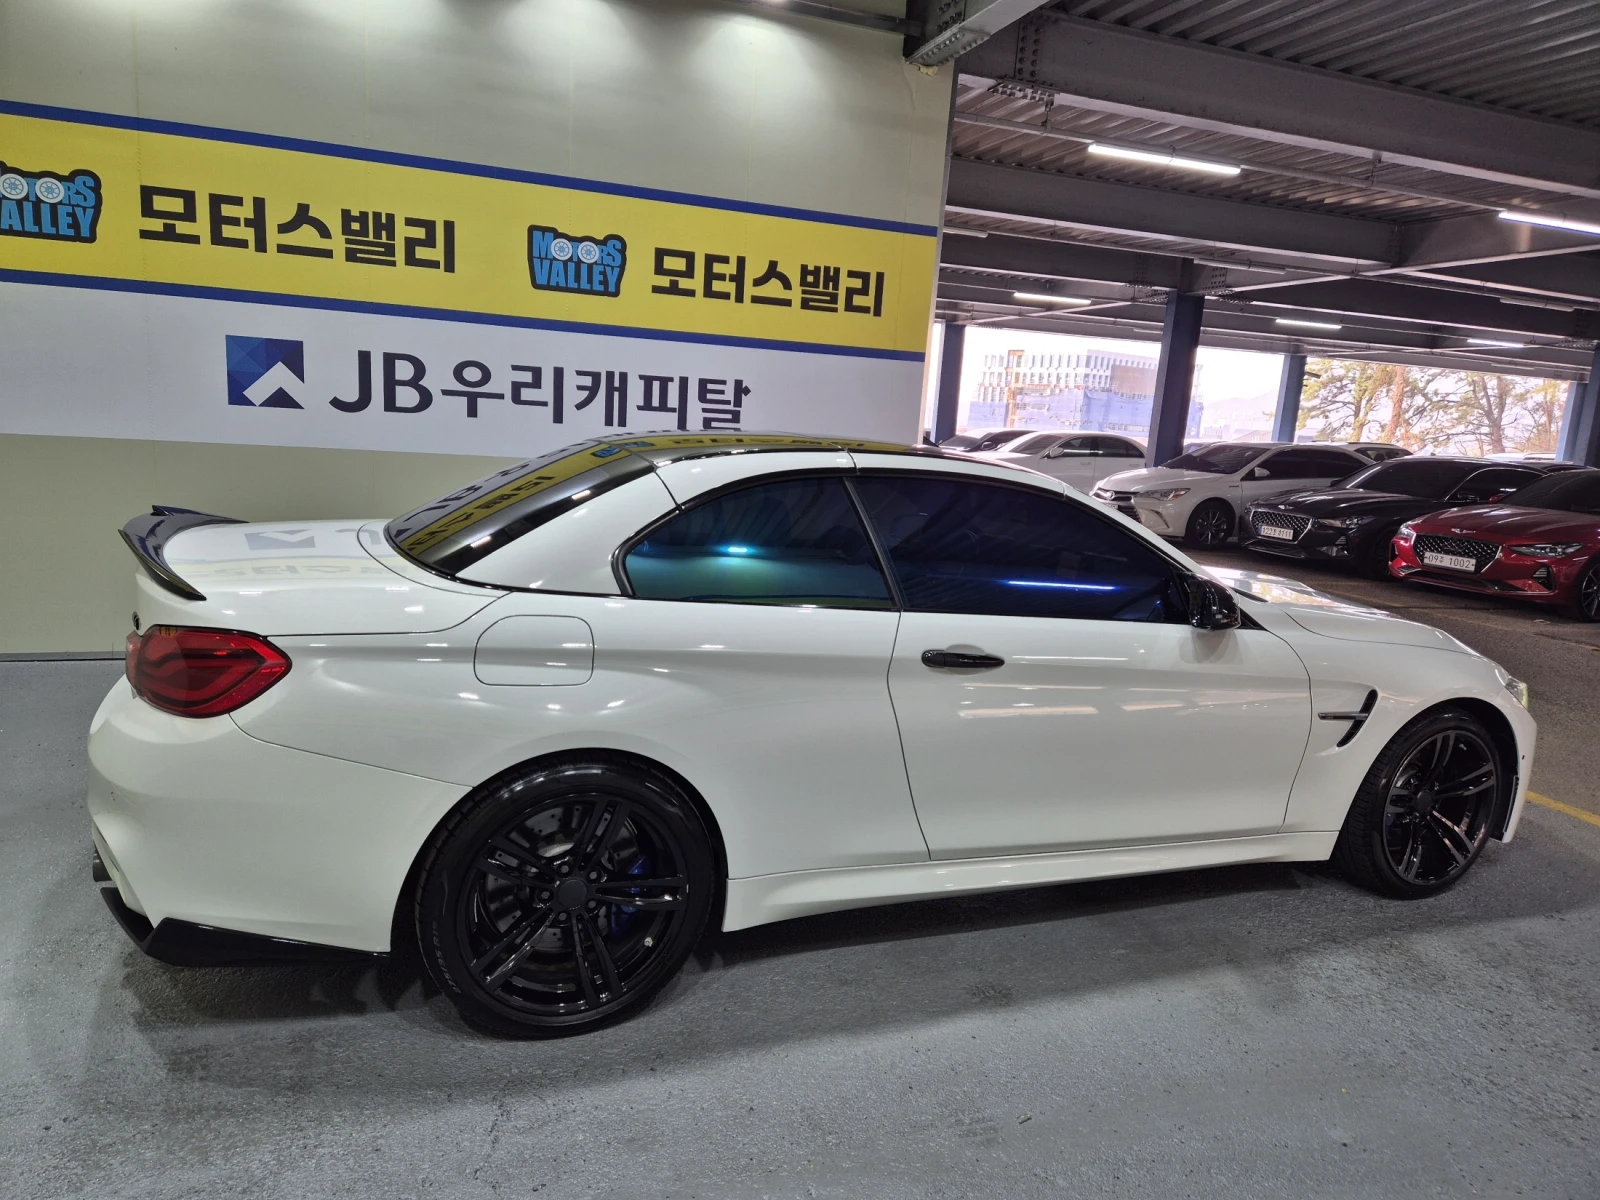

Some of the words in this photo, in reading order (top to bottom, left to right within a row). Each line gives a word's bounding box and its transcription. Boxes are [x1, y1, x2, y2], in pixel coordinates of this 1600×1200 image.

[0, 173, 96, 207] OTORS
[0, 199, 95, 238] ALLEY
[139, 184, 456, 273] 모터스밸리
[532, 230, 622, 267] MOTORS
[533, 257, 621, 293] VALLEY
[651, 246, 886, 318] 모터스밸리
[328, 349, 752, 431] JB우리캐피탈
[1448, 557, 1471, 569] 1002
